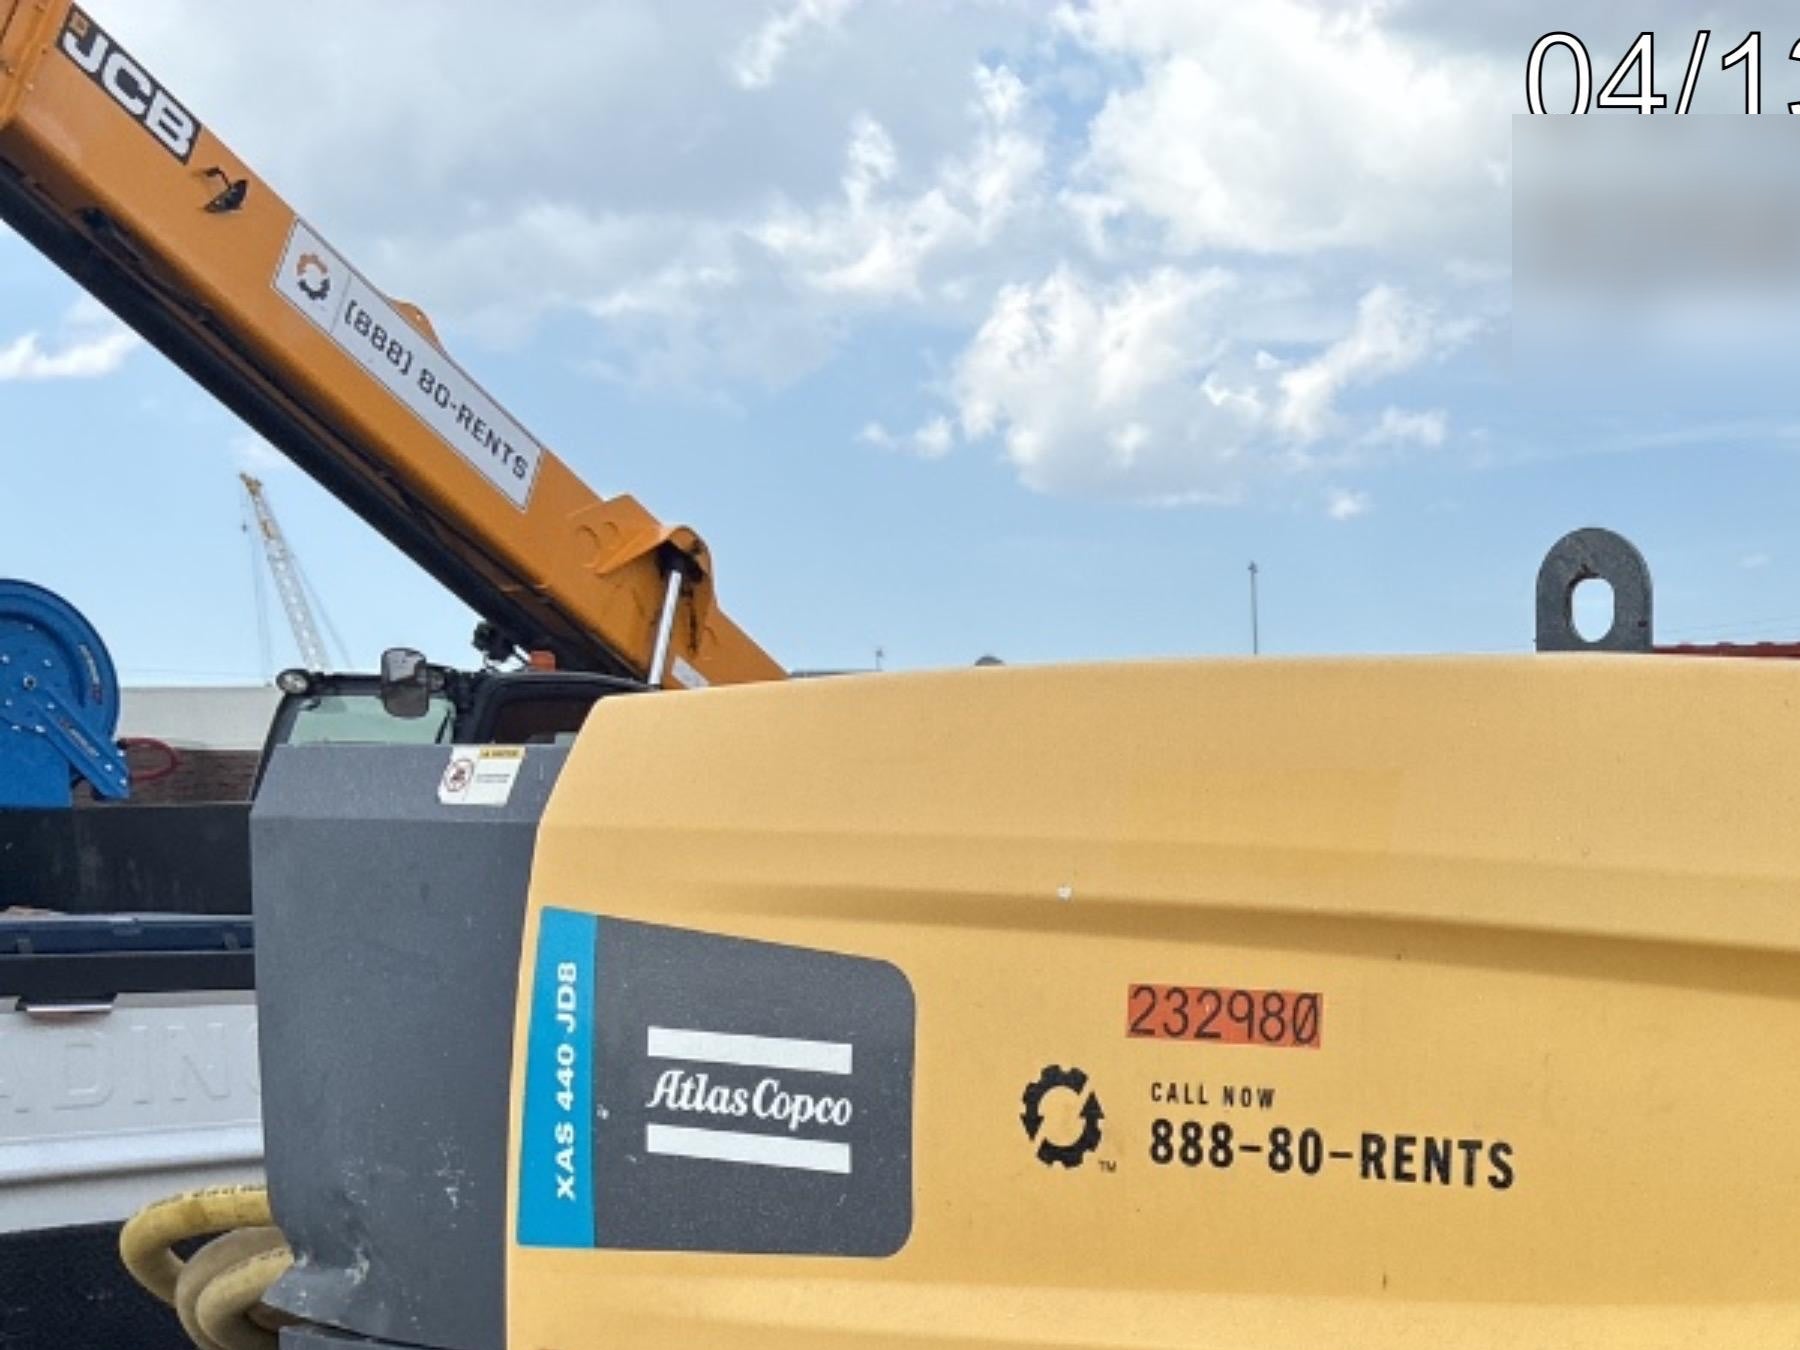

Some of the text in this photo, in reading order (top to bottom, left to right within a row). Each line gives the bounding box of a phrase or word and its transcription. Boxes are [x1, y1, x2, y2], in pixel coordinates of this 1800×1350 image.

[62, 32, 195, 157] JCB
[417, 368, 530, 481] 80-RENTS
[1130, 985, 1319, 1045] 232980
[556, 961, 577, 1201] XAS 440 JD8
[1150, 1082, 1277, 1109] CALL NOW
[1150, 1117, 1515, 1190] 888-80-RENTS
